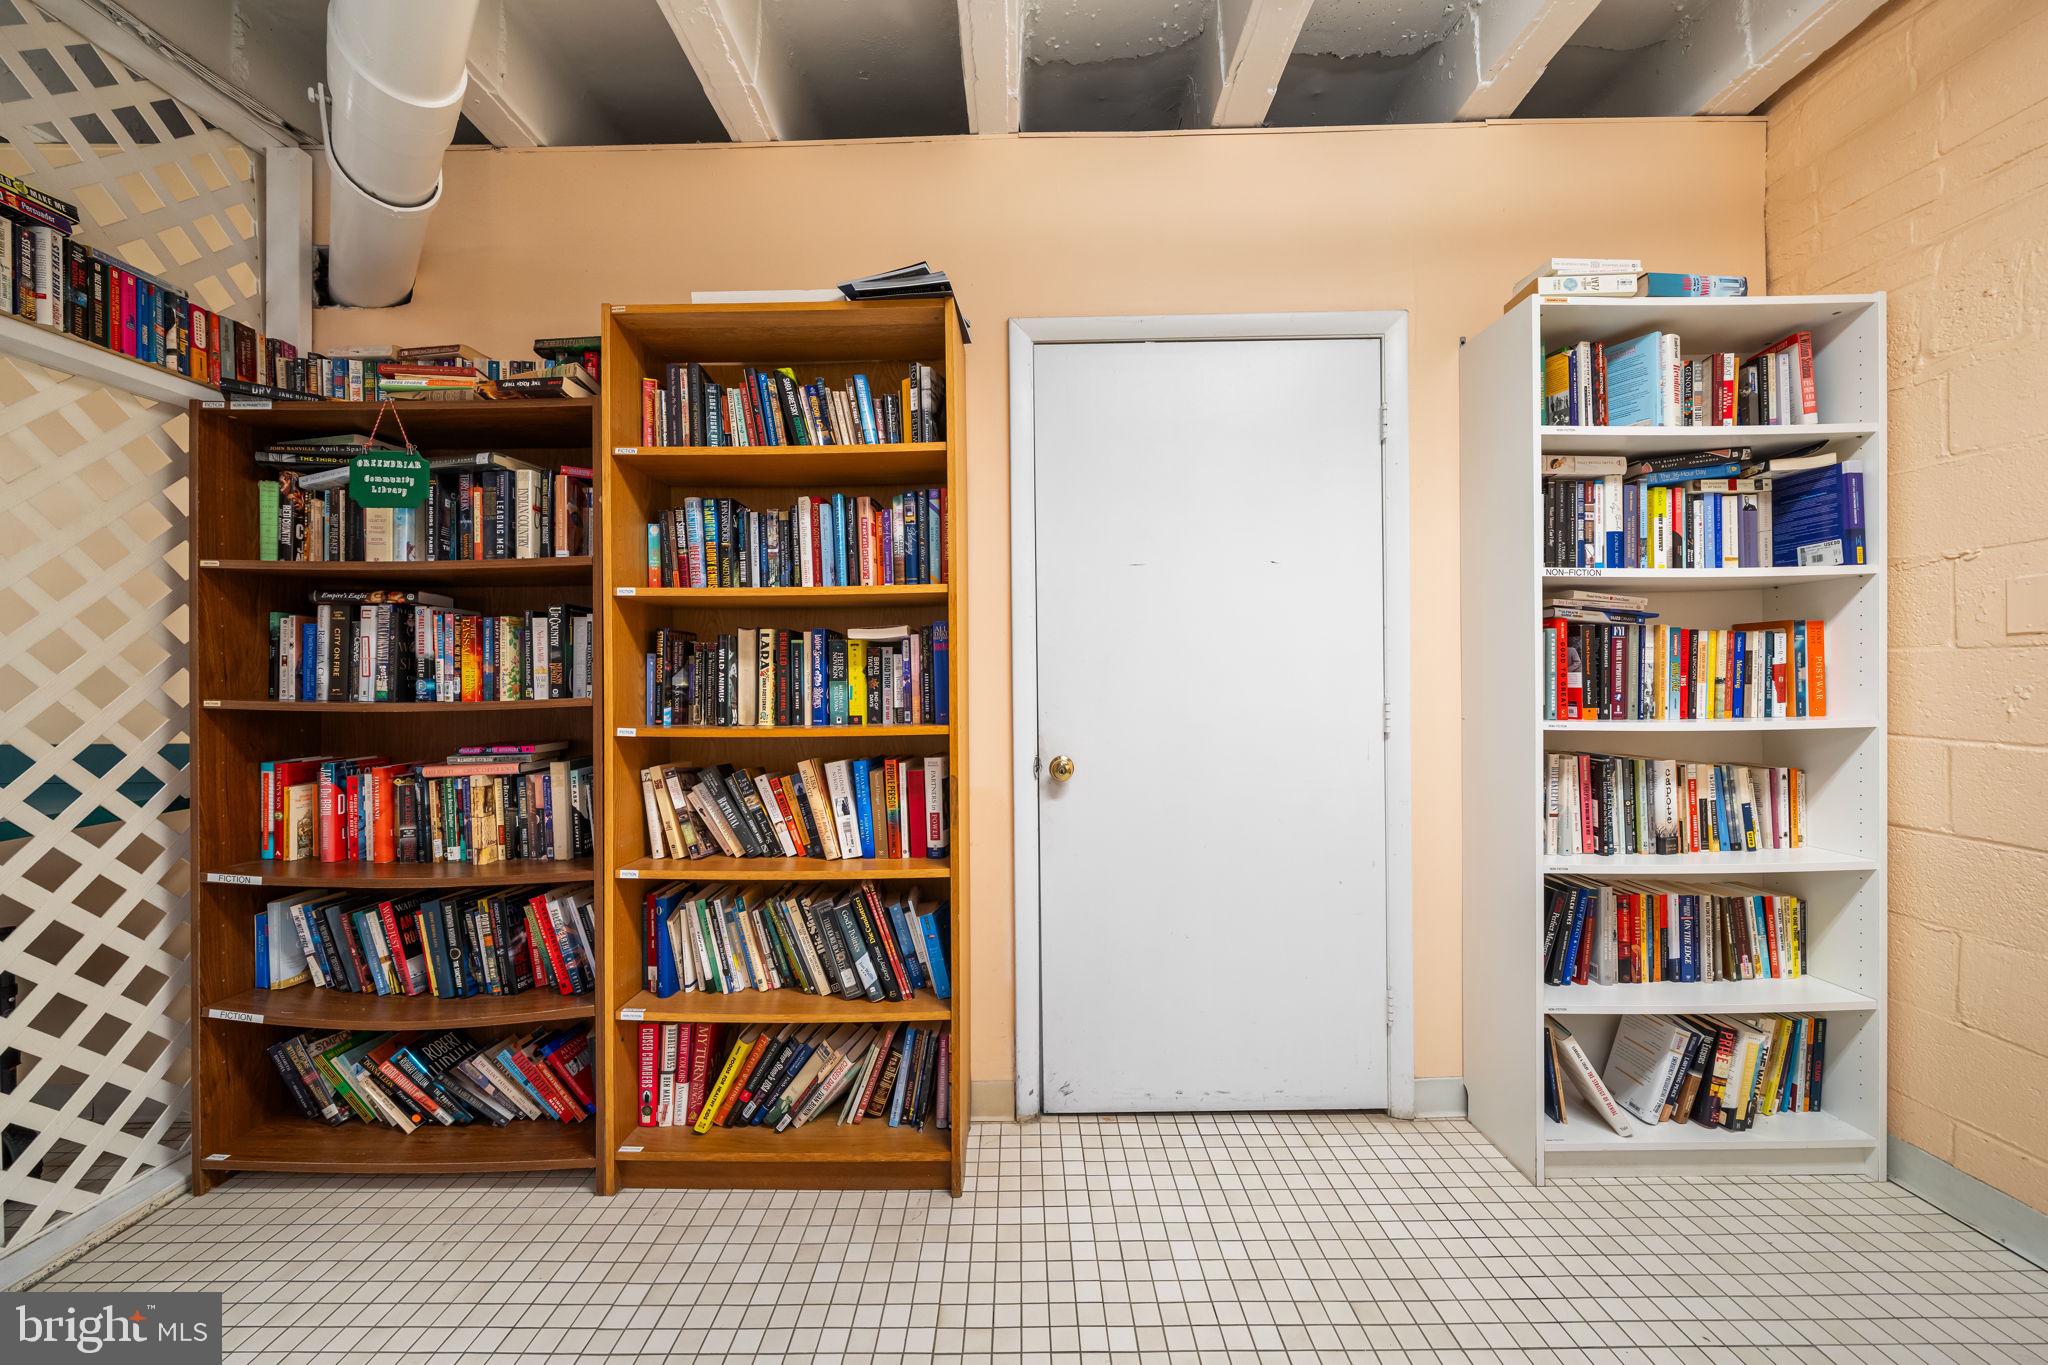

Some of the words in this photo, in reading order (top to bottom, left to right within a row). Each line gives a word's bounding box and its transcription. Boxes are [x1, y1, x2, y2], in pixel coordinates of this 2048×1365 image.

[29, 189, 53, 206] MAKE
[54, 200, 67, 213] ME
[51, 242, 60, 273] STEVE
[51, 272, 61, 302] BERRY
[251, 387, 272, 395] DRY
[782, 377, 793, 391] SARA
[1684, 366, 1692, 398] GENOME
[787, 391, 799, 416] PARETSKY
[711, 434, 719, 447] RIVE
[356, 459, 422, 469] GREENBRIAR
[1659, 472, 1671, 480] The
[1695, 469, 1707, 477] Day
[363, 475, 415, 487] Community
[371, 486, 408, 497] Library
[283, 504, 291, 518] RED
[517, 488, 529, 514] INDIAN
[495, 500, 504, 534] LEADING
[687, 509, 700, 543] SANDFORD
[703, 506, 715, 541] SANDFORD
[281, 518, 291, 546] COUNTRY
[517, 514, 529, 548] COUNTRY
[496, 538, 504, 555] MEN
[689, 544, 701, 562] DEEP
[705, 541, 716, 565] BLOODY
[690, 563, 702, 585] FREEZE
[707, 566, 718, 589] GENIUS
[862, 558, 870, 579] Sally's
[1545, 568, 1602, 577] NON-FICTION
[334, 647, 341, 660] ON
[655, 630, 664, 656] STUART
[779, 632, 788, 666] DERAILED
[656, 657, 664, 683] WOODS
[1735, 659, 1743, 689] Mothering
[1815, 656, 1823, 700] POSTWAR
[801, 769, 814, 799] WINGATE
[809, 775, 817, 790] LISA
[831, 771, 839, 791] NIXON
[836, 764, 845, 795] PRESIDENT
[886, 763, 895, 785] PEOPLE
[887, 785, 897, 808] PERSON
[717, 796, 740, 829] BETRAYAL
[931, 813, 940, 839] POWER
[219, 875, 251, 883] FICTION
[1569, 890, 1577, 910] STOLEN
[382, 905, 394, 931] WARD
[1566, 910, 1574, 926] LIVES
[1684, 919, 1692, 930] ON
[387, 931, 400, 949] JUST
[841, 909, 855, 929] God's
[848, 929, 863, 953] Politics
[1684, 931, 1692, 945] THE
[220, 1012, 252, 1021] FICTION
[642, 1028, 653, 1051] CLOSED
[698, 1026, 709, 1049] MY
[756, 1039, 767, 1051] THE
[692, 1050, 708, 1083] TURN
[724, 1056, 737, 1075] FOODS
[745, 1053, 759, 1072] GREAT
[780, 1046, 793, 1065] Oliver
[641, 1052, 653, 1088] CHAMBERS
[719, 1075, 728, 1085] FOR
[767, 1061, 785, 1081] Stone's
[831, 1060, 848, 1080] CURSED
[1814, 1060, 1822, 1082] CHAOS
[690, 1082, 699, 1110] REAGAN
[696, 1083, 705, 1106] NANCY
[729, 1073, 749, 1102] WARMING
[760, 1080, 773, 1093] USA
[822, 1078, 834, 1092] DAYS
[861, 1076, 876, 1106] CHICKENS
[1587, 1071, 1595, 1080] THE
[1591, 1078, 1605, 1097] STRATEGY
[1606, 1102, 1618, 1117] DENIAL
[709, 1086, 723, 1108] HEALTHY
[813, 1090, 825, 1103] IVAN
[702, 1109, 713, 1121] KIDS
[802, 1101, 818, 1117] BUNIN
